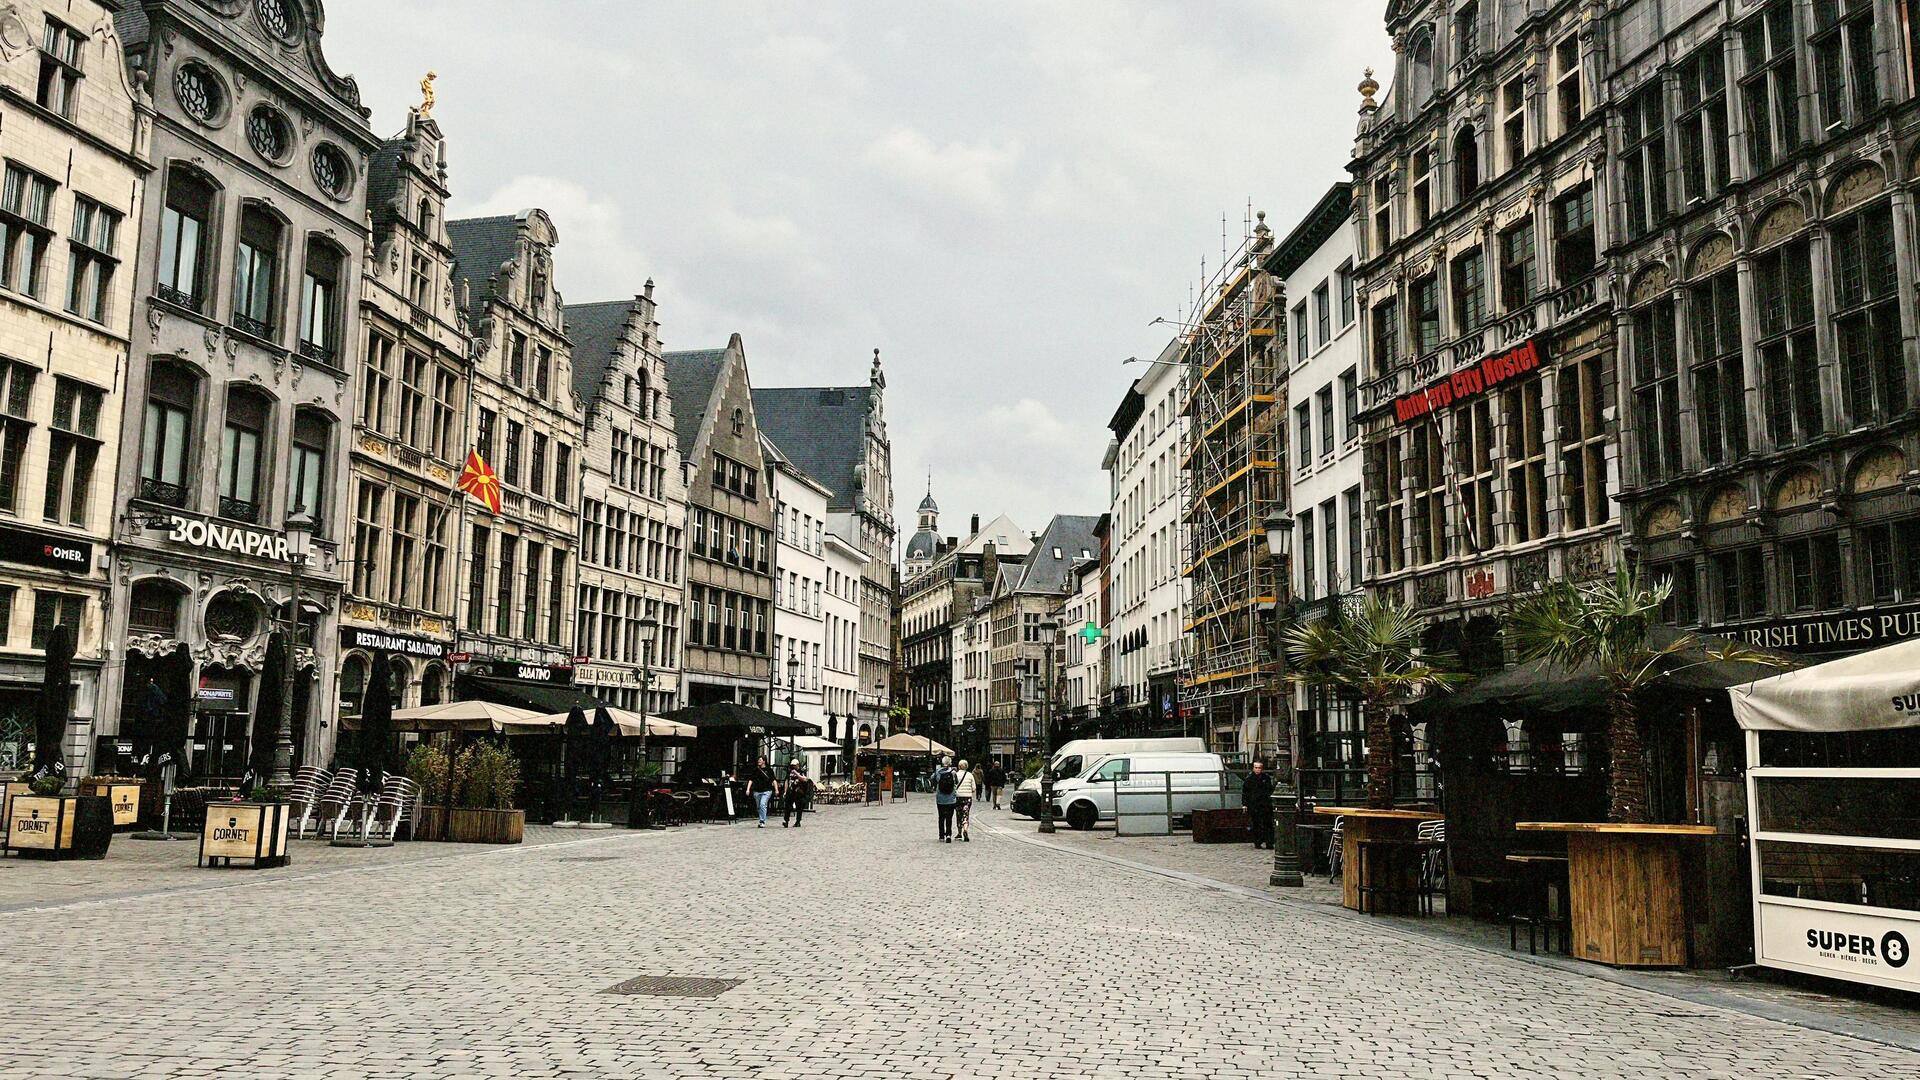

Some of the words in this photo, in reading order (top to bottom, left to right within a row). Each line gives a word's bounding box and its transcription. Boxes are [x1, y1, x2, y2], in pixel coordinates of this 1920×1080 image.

[1395, 382, 1452, 423] Antwerp
[1451, 367, 1483, 399] City
[1481, 339, 1540, 387] Hostel
[169, 515, 318, 567] BONAPARE
[356, 632, 407, 651] RESTAURANT
[406, 640, 443, 657] SABATINO
[1743, 625, 1798, 648] IRISH
[1803, 616, 1873, 644] TIMES
[518, 666, 551, 681] SABATINO
[18, 820, 49, 833] CORNET
[213, 828, 249, 842] CORNET
[1806, 928, 1877, 957] SUPER
